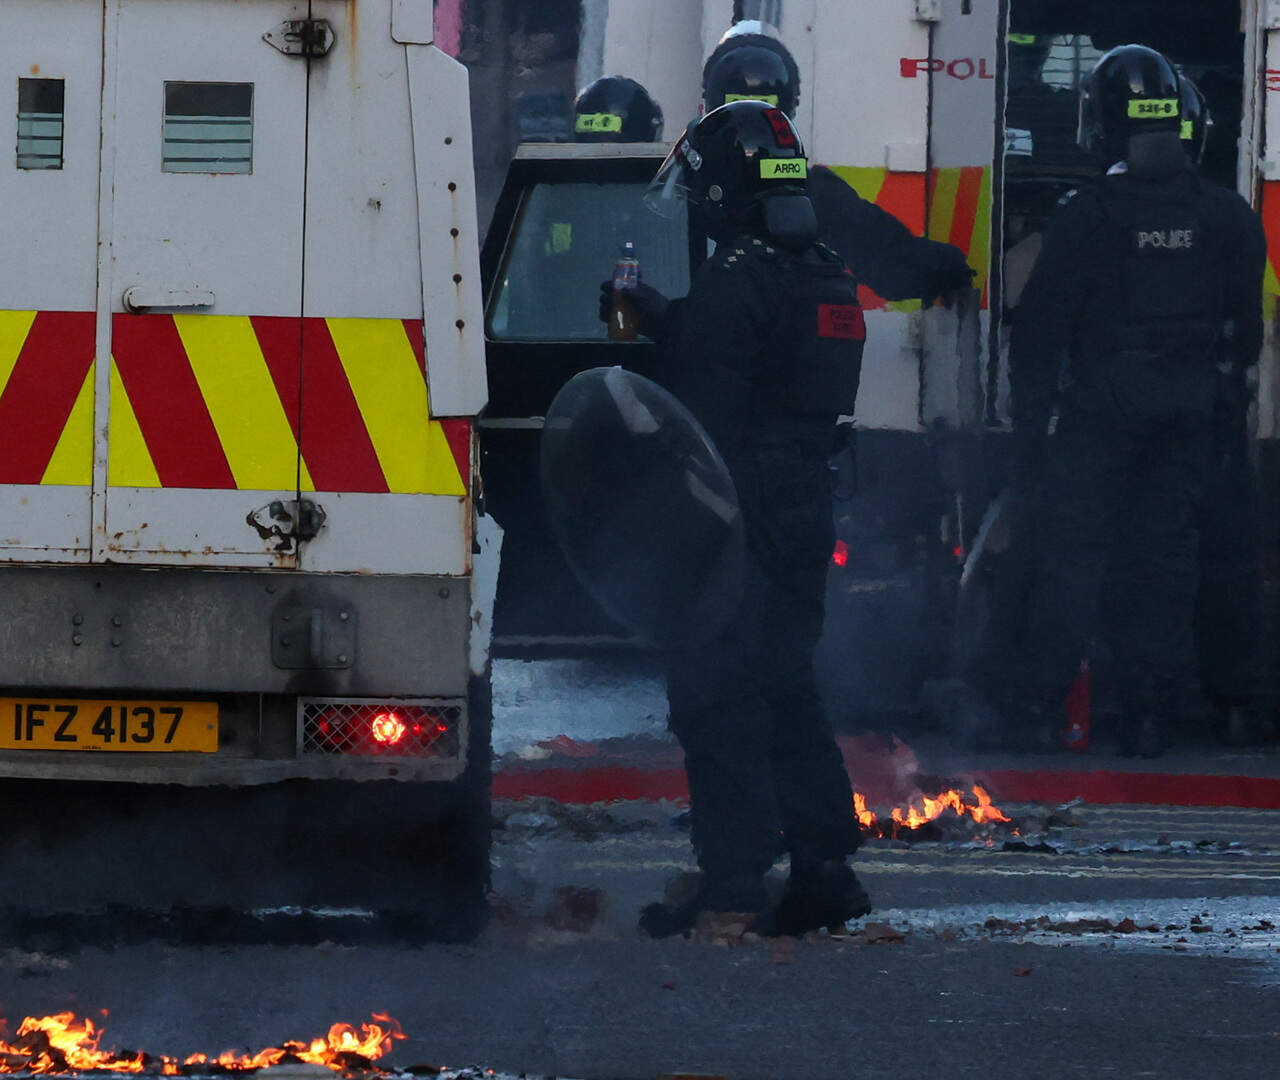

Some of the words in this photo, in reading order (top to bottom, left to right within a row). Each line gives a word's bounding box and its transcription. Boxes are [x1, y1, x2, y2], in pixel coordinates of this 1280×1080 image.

[773, 163, 801, 174] ARRO
[1138, 229, 1193, 249] POLICE
[13, 703, 79, 742] IFZ
[91, 705, 184, 744] 4137
